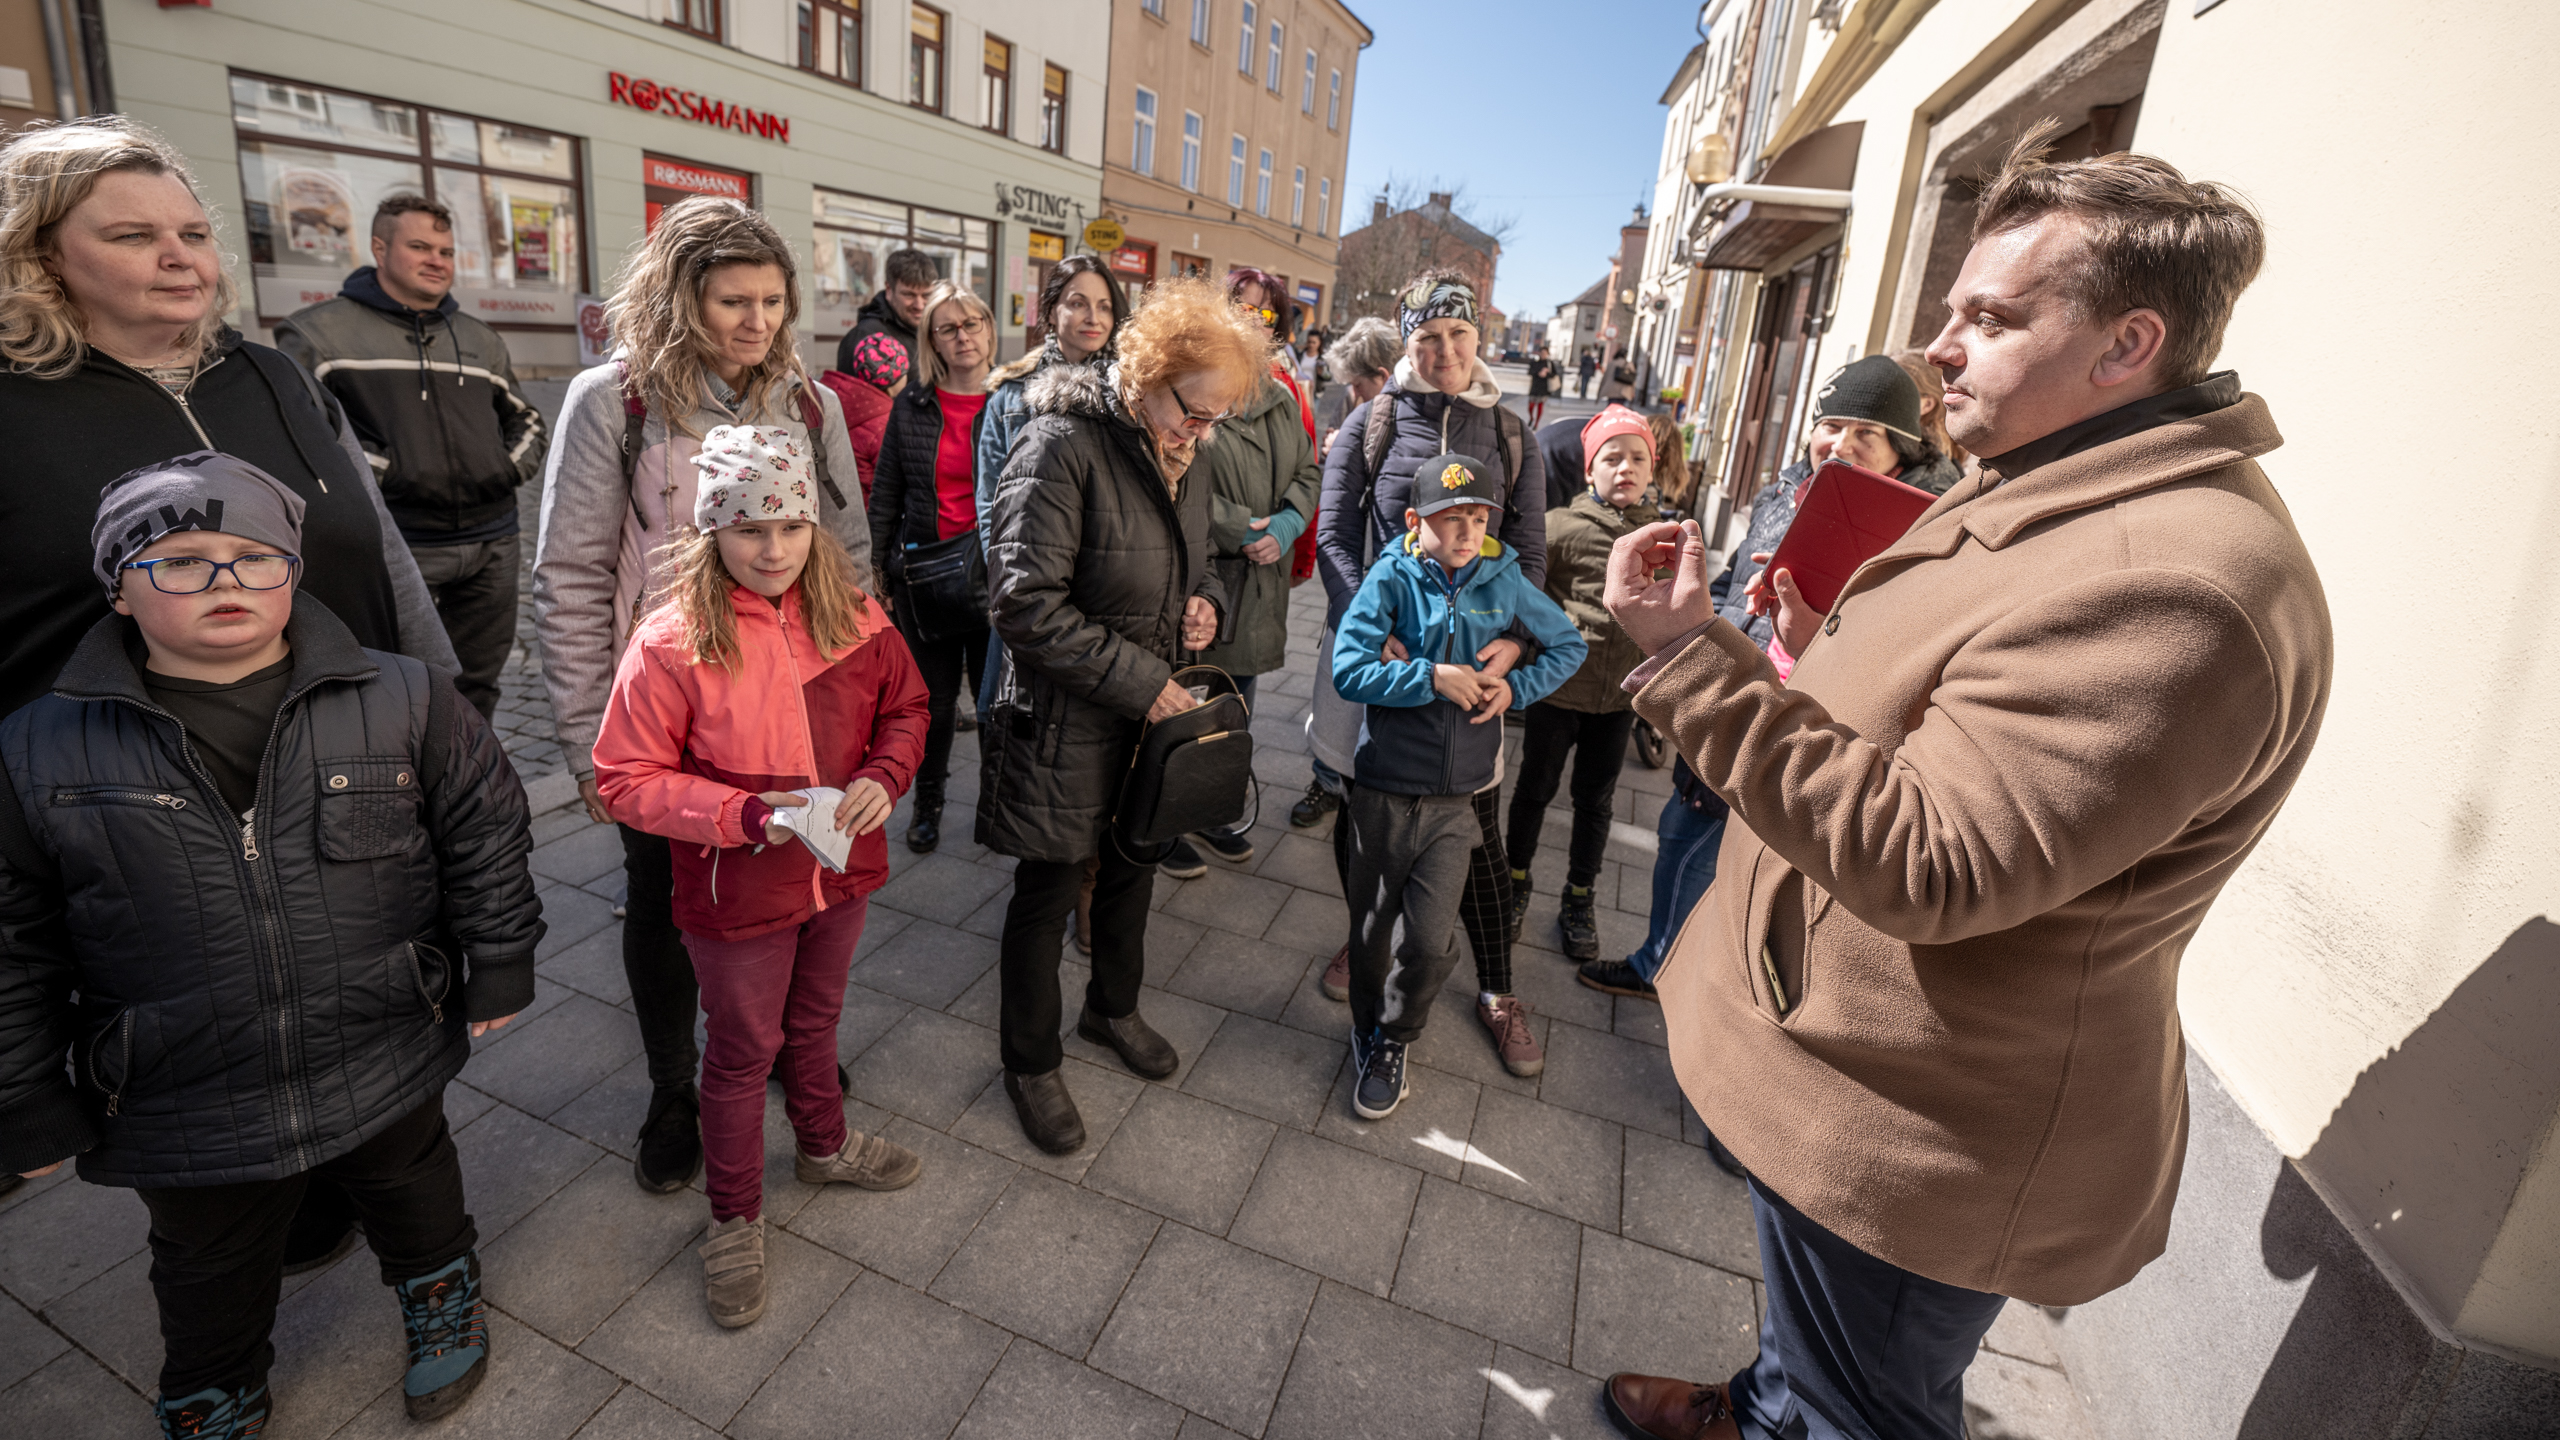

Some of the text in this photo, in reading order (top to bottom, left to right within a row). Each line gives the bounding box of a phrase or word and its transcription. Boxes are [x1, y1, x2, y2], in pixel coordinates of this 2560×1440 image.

[609, 71, 790, 143] ROSSMANN
[653, 164, 740, 194] ROSSMANN
[1012, 185, 1070, 219] STING
[1090, 229, 1119, 240] STING
[479, 297, 556, 314] ROSSMANN
